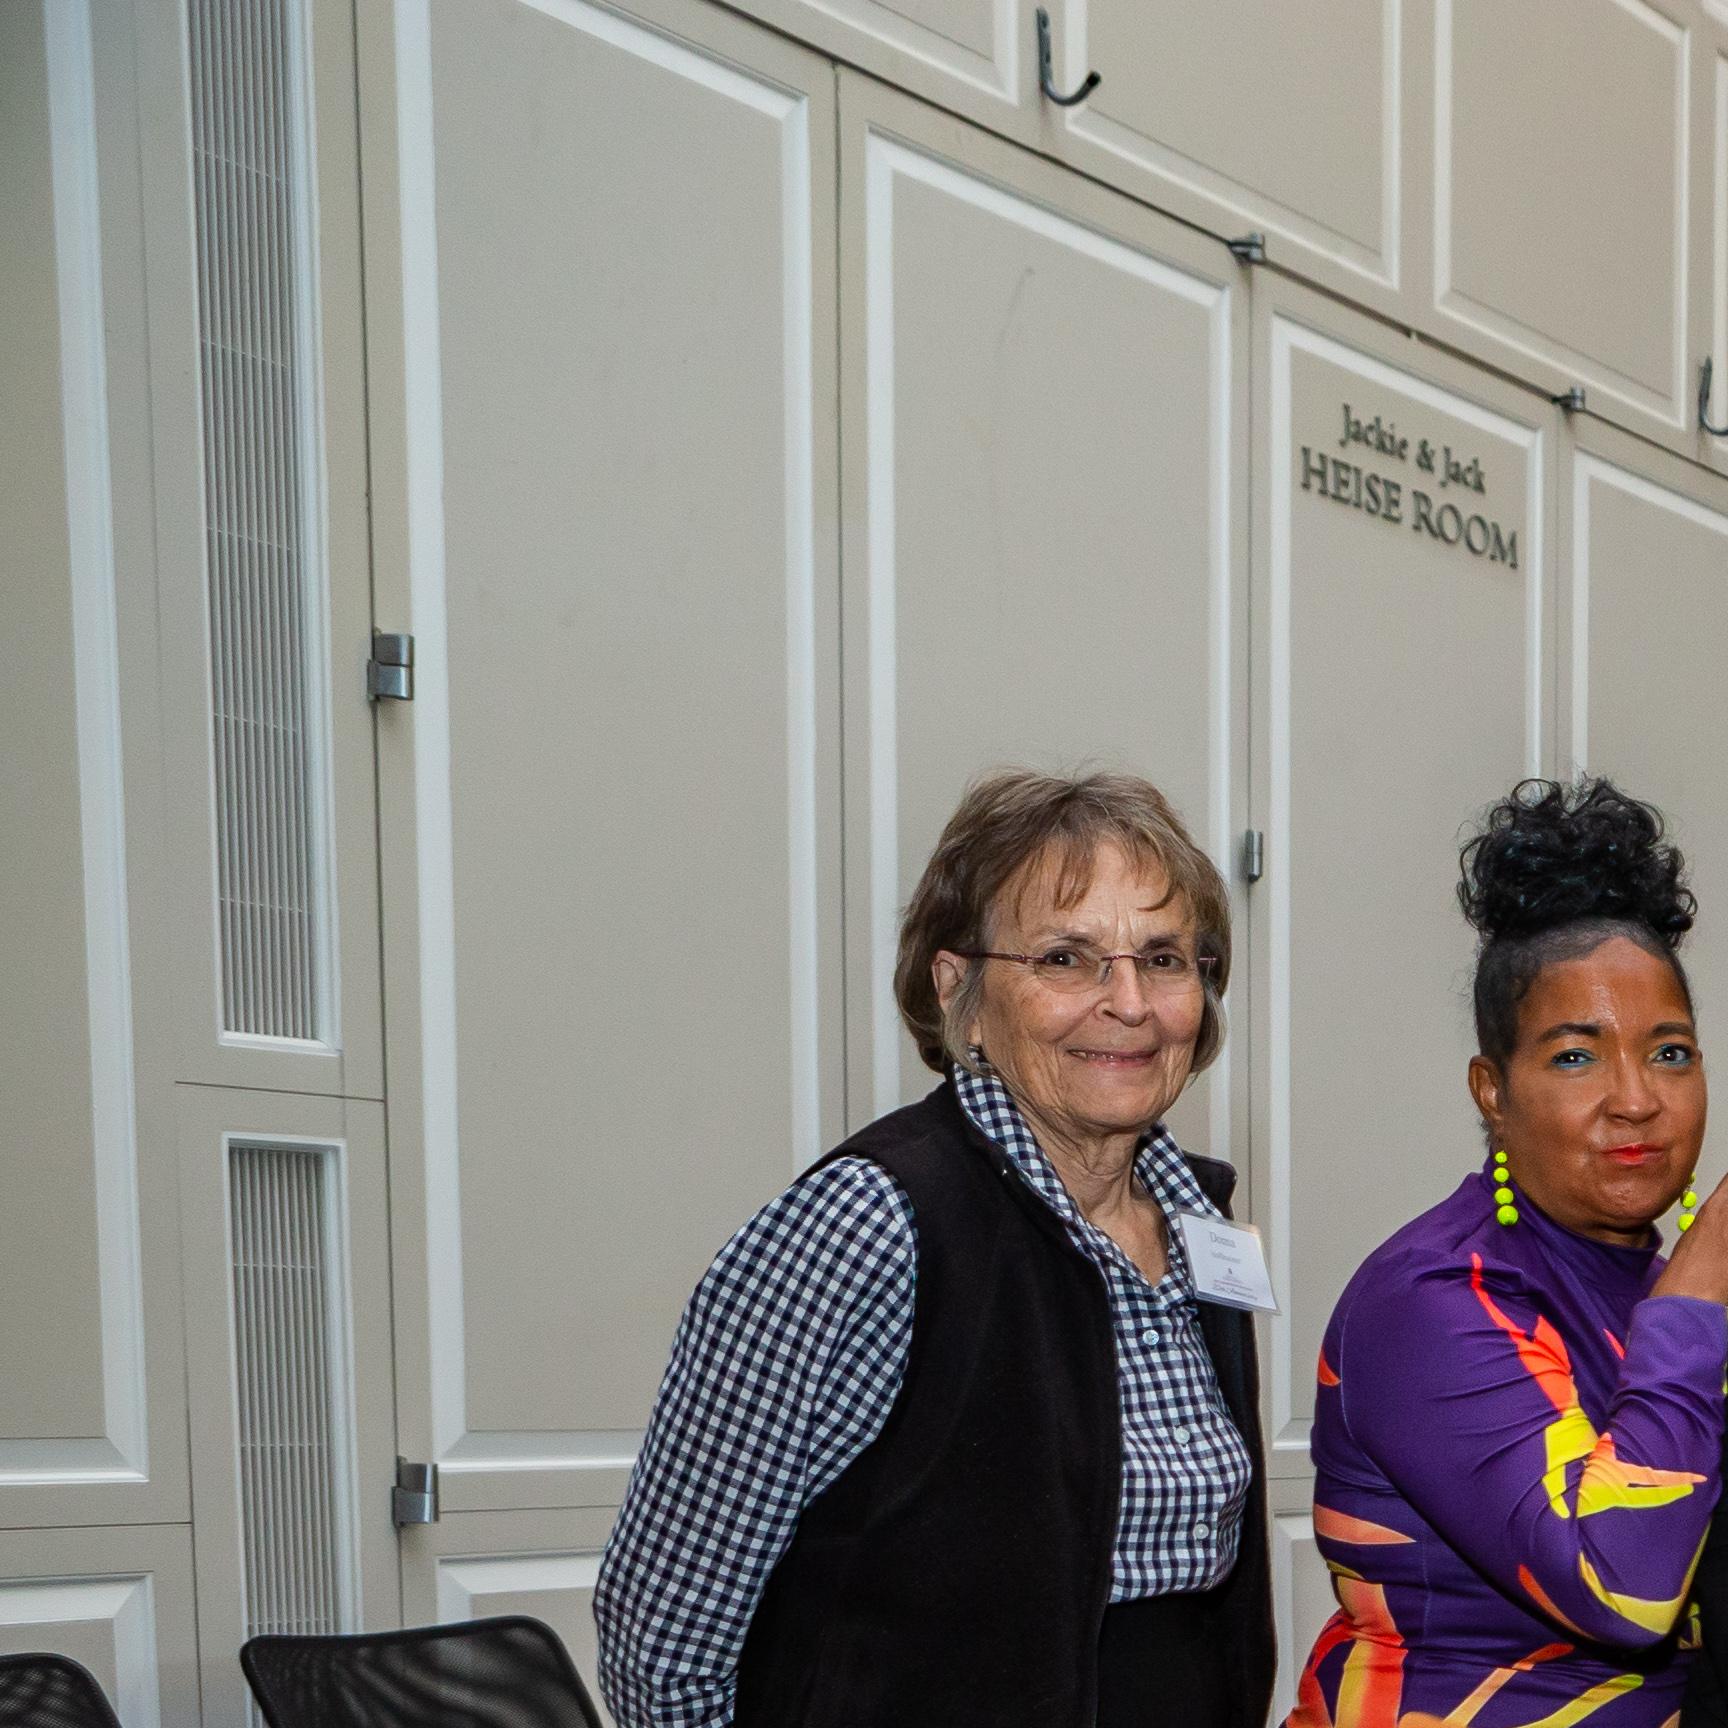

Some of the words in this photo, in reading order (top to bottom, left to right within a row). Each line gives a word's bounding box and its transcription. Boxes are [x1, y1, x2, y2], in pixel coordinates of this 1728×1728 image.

[1339, 403, 1408, 461] Jackie
[1416, 438, 1435, 474] &
[1440, 447, 1485, 493] Jack
[1301, 446, 1402, 524] HEISE
[1412, 490, 1520, 570] ROOM
